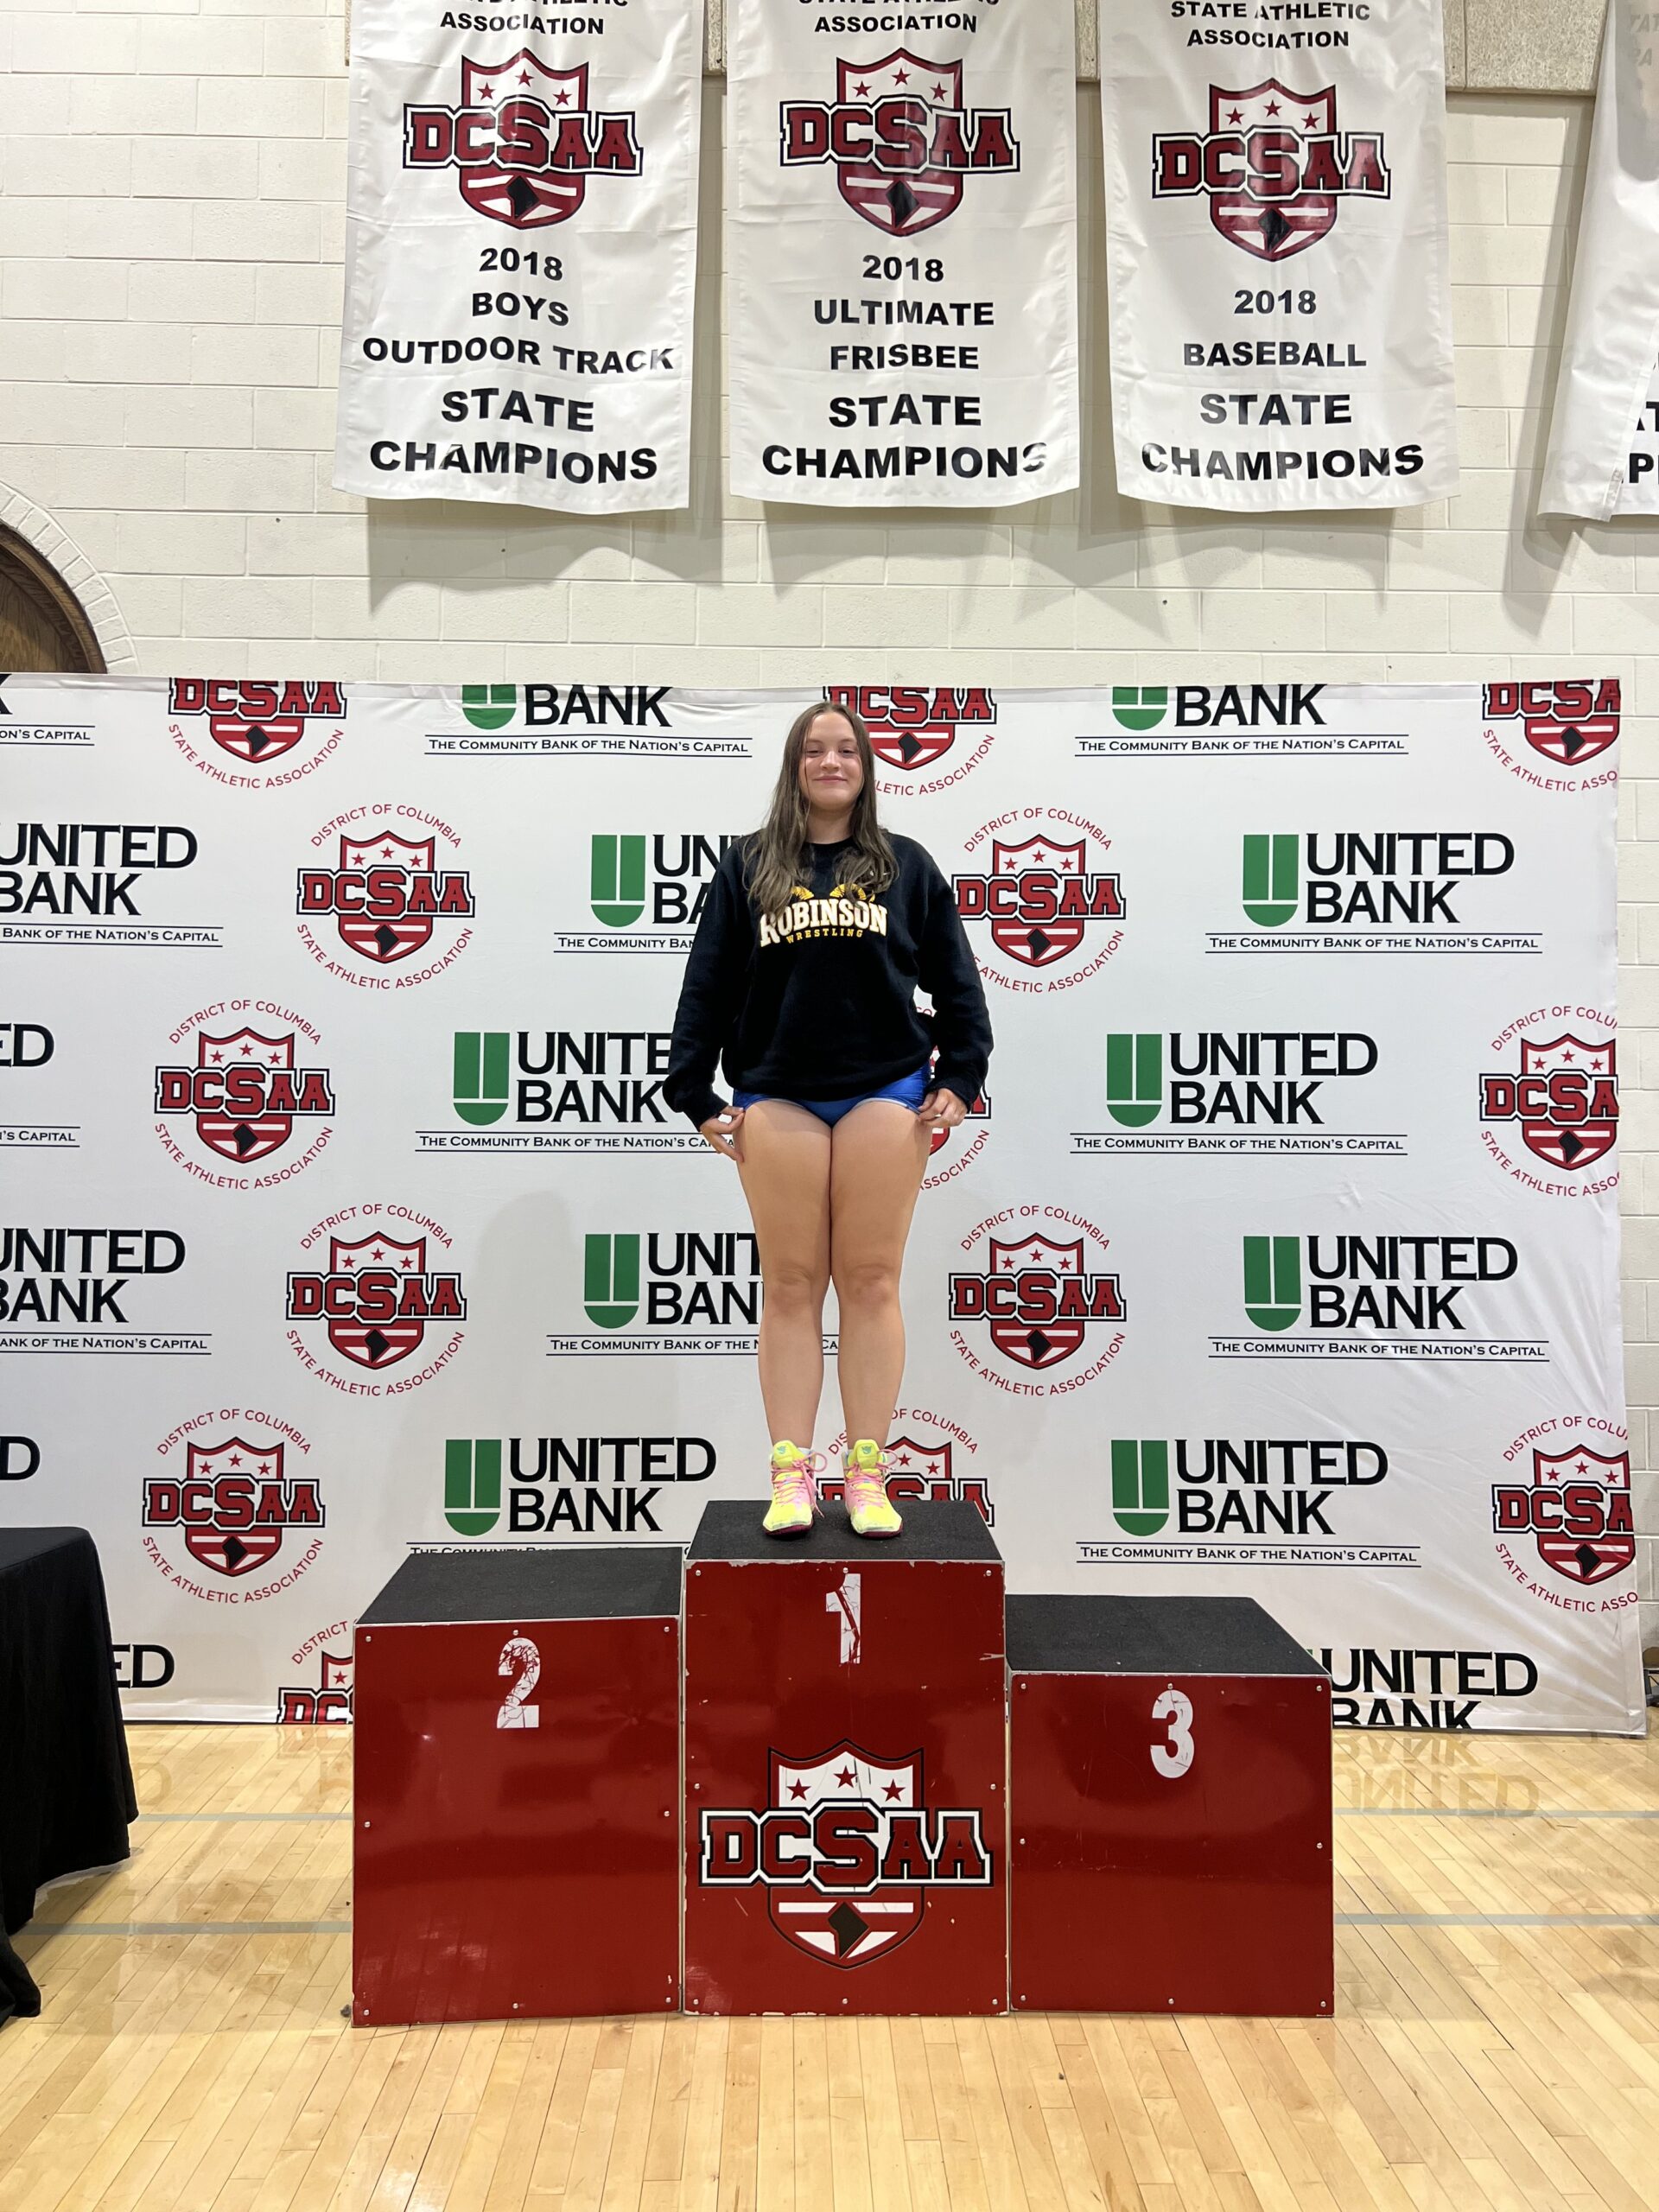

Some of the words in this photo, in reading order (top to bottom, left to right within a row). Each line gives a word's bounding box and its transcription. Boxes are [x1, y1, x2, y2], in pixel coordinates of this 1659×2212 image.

[441, 12, 603, 34] ASSOCIATION
[815, 14, 976, 33] ASSOCIATION
[1172, 1, 1247, 17] STATE
[1255, 3, 1370, 20] ATHLETIC
[1187, 29, 1348, 49] ASSOCIATION
[403, 95, 643, 176] DCSAA
[779, 93, 1020, 174] DCSAA
[1153, 124, 1390, 201] DCSAA
[480, 248, 563, 280] 2018
[863, 255, 944, 282] 2018
[473, 292, 569, 326] BOYS
[815, 299, 994, 326] ULTIMATE
[1235, 290, 1316, 314] 2018
[363, 336, 540, 365] OUTDOOR
[553, 346, 672, 373] TRACK
[831, 344, 978, 370] FRISBEE
[1185, 342, 1366, 366] BASEBALL
[442, 388, 593, 431] STATE
[830, 394, 981, 427] STATE
[1201, 394, 1351, 425] STATE
[371, 442, 657, 484] CHAMPIONS
[763, 443, 1046, 478] CHAMPIONS
[1142, 444, 1423, 480] CHAMPIONS
[168, 677, 346, 718] DCSAA
[524, 684, 672, 727] BANK
[1175, 684, 1327, 726] BANK
[168, 725, 195, 761] STATE
[196, 760, 260, 789] ATHLETIC
[264, 729, 344, 788] ASSOCIATION
[918, 735, 995, 795] ASSOCIATION
[1483, 728, 1512, 766] STATE
[1512, 766, 1575, 792] ATHLETIC
[310, 805, 366, 847] DISTRICT
[372, 803, 391, 816] OF
[397, 804, 461, 848] COLUMBIA
[964, 810, 1017, 853] DISTRICT
[1023, 807, 1041, 819] OF
[1047, 807, 1111, 849] COLUMBIA
[1306, 833, 1514, 875] UNITED
[296, 866, 475, 917] DCSAA
[951, 869, 1125, 921] DCSAA
[1306, 881, 1459, 923] BANK
[760, 898, 887, 947] ROBINSON
[785, 927, 863, 944] WRESTLING
[298, 925, 326, 962] STATE
[325, 962, 388, 988] ATHLETIC
[395, 929, 472, 988] ASSOCIATION
[981, 967, 1042, 994] ATHLETIC
[1047, 931, 1124, 992] ASSOCIATION
[168, 1002, 225, 1046] DISTRICT
[231, 1000, 250, 1010] OF
[255, 1001, 321, 1045] COLUMBIA
[1491, 1008, 1546, 1052] DISTRICT
[1551, 1006, 1569, 1017] OF
[1170, 1033, 1377, 1076] UNITED
[155, 1063, 335, 1118] DCSAA
[516, 1080, 668, 1122] BANK
[1170, 1081, 1324, 1124] BANK
[1479, 1069, 1618, 1126] DCSA
[156, 1123, 183, 1162] STATE
[184, 1162, 247, 1190] ATHLETIC
[254, 1128, 333, 1187] ASSOCIATION
[1482, 1131, 1510, 1169] STATE
[1510, 1169, 1577, 1196] ATHLETIC
[300, 1206, 357, 1249] DISTRICT
[362, 1203, 381, 1216] OF
[386, 1205, 453, 1248] COLUMBIA
[962, 1208, 1014, 1249] DISTRICT
[1019, 1205, 1039, 1217] OF
[1043, 1205, 1109, 1249] COLUMBIA
[1307, 1236, 1517, 1281] UNITED
[286, 1268, 467, 1322] DCSAA
[949, 1268, 1126, 1322] DCSAA
[1309, 1285, 1465, 1329] BANK
[287, 1330, 315, 1367] STATE
[315, 1368, 379, 1397] ATHLETIC
[386, 1332, 464, 1394] ASSOCIATION
[950, 1331, 978, 1368] STATE
[979, 1368, 1043, 1397] ATHLETIC
[1049, 1333, 1125, 1395] ASSOCIATION
[157, 1412, 213, 1456] DISTRICT
[219, 1409, 238, 1421] OF
[245, 1409, 311, 1453] COLUMBIA
[912, 1409, 978, 1452] COLUMBIA
[1503, 1420, 1558, 1462] DISTRICT
[1561, 1416, 1581, 1428] OF
[509, 1437, 716, 1482] UNITED
[1175, 1440, 1388, 1485] UNITED
[143, 1473, 326, 1530] DCSAA
[508, 1488, 662, 1532] BANK
[1177, 1489, 1335, 1535] BANK
[1492, 1480, 1634, 1540] DCSA
[142, 1537, 172, 1576] STATE
[171, 1575, 238, 1605] ATHLETIC
[244, 1539, 324, 1603] ASSOCIATION
[1495, 1544, 1528, 1584] STATE
[1527, 1582, 1596, 1614] ATHLETIC
[826, 1573, 861, 1664] 1
[291, 1620, 348, 1665] DISTRICT
[497, 1637, 540, 1728] 2
[1321, 1649, 1538, 1697] UNITED
[1150, 1690, 1195, 1778] 3
[698, 1798, 995, 1894] DCSAA
